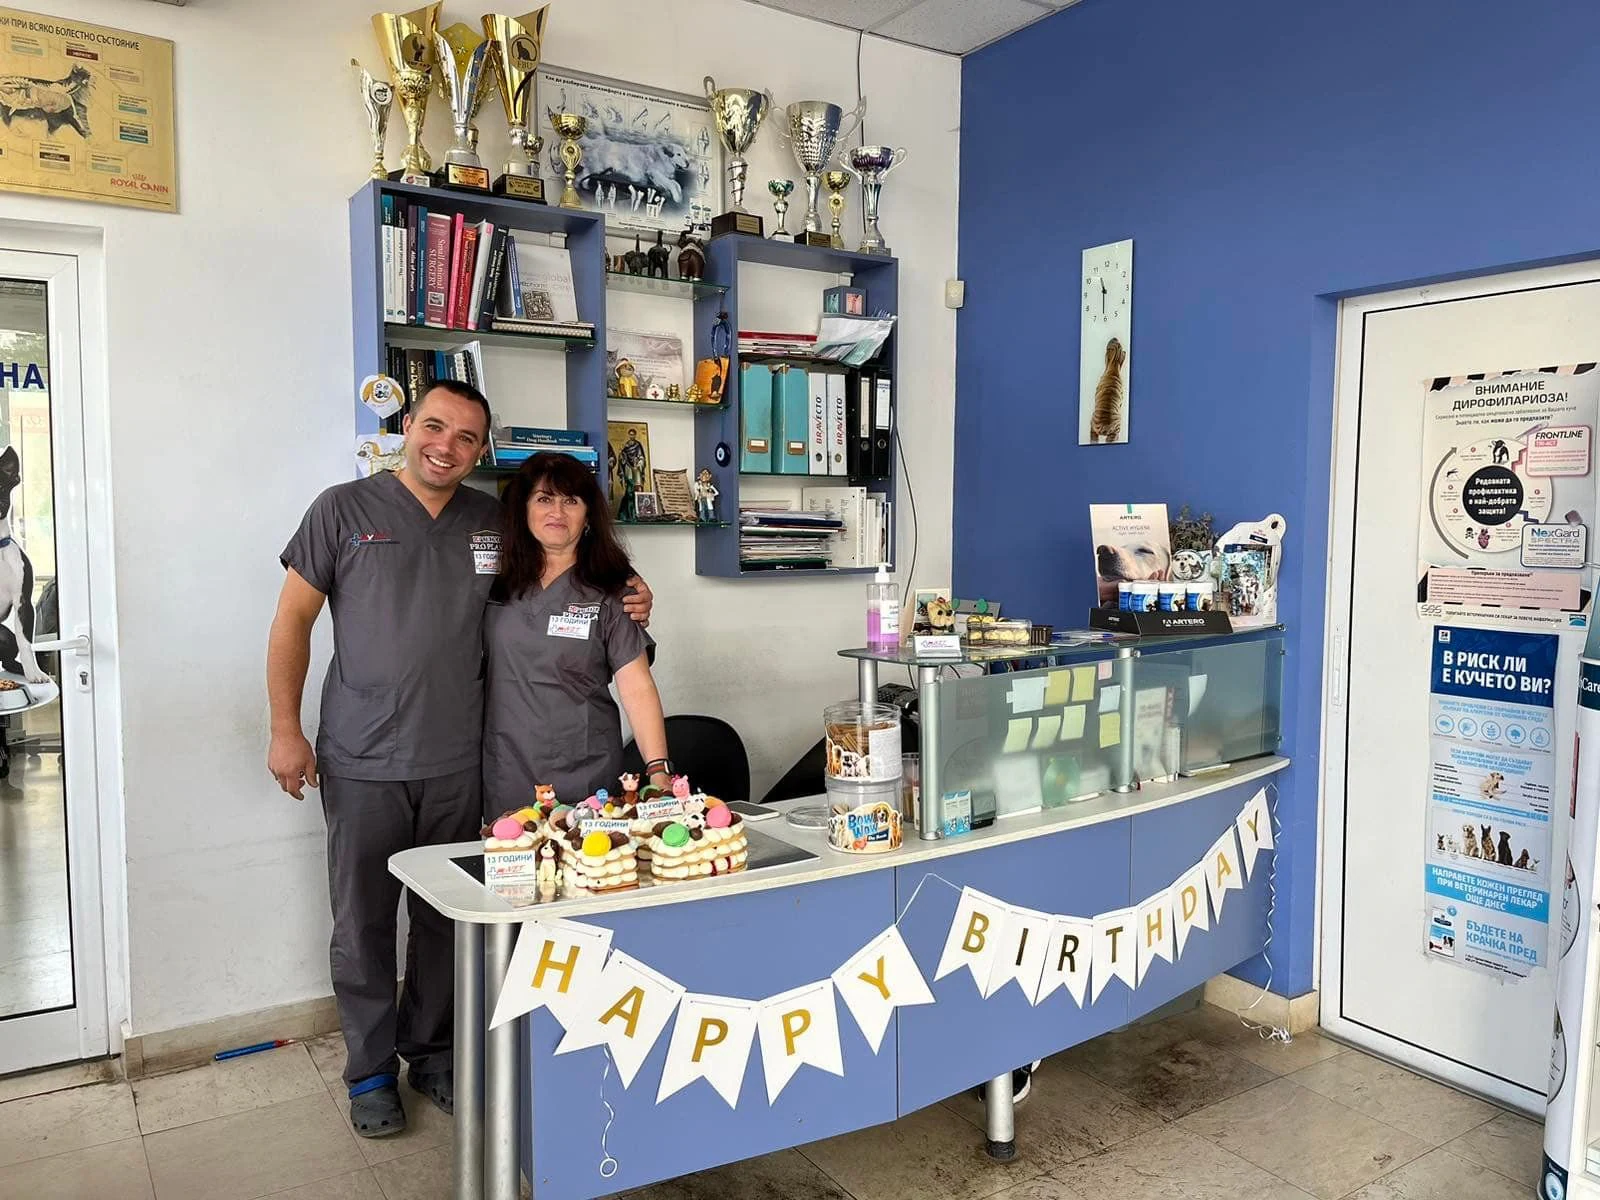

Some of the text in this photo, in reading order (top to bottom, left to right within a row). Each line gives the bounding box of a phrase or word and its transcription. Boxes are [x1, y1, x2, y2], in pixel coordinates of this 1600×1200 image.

[11, 18, 28, 28] ПРИ
[29, 21, 54, 34] ВСЯКО
[56, 26, 96, 42] БОЛЕСТНО
[96, 34, 140, 50] СЪСТОЯНИЕ
[110, 178, 138, 190] ROYAL
[140, 182, 168, 194] CANIN
[428, 248, 437, 288] SURGERY
[436, 238, 446, 289] Small Animal
[1475, 380, 1545, 396] ВНИМАНИЕ
[1452, 392, 1568, 412] ДИРОФИЛАРИОЗА!
[814, 396, 823, 445] BRAVECTO
[1535, 430, 1583, 440] FRONTLINE
[1468, 488, 1517, 496] профилактика
[1531, 528, 1580, 537] NexGard
[1443, 650, 1526, 672] В РИСК ЛИ
[1442, 668, 1552, 694] Е КУЧЕТО ВИ?
[648, 800, 680, 809] ГОДИНИ
[498, 854, 533, 863] ГОДИНИ
[962, 809, 1259, 973] BIRTHDAY
[1432, 867, 1544, 904] НАПРАВЕТЕ КОЖЕН ПРЕГЛЕД
[1437, 877, 1538, 909] ПРИ ВЕТЕРИНАРЕН ЛЕКАР
[1465, 894, 1506, 911] ОЩЕ ДНЕС
[1467, 920, 1524, 944] БЪДЕТЕ НА
[1466, 932, 1507, 952] КРАЧКА
[1508, 945, 1537, 962] ПРЕД
[530, 940, 892, 1063] HAPPY
